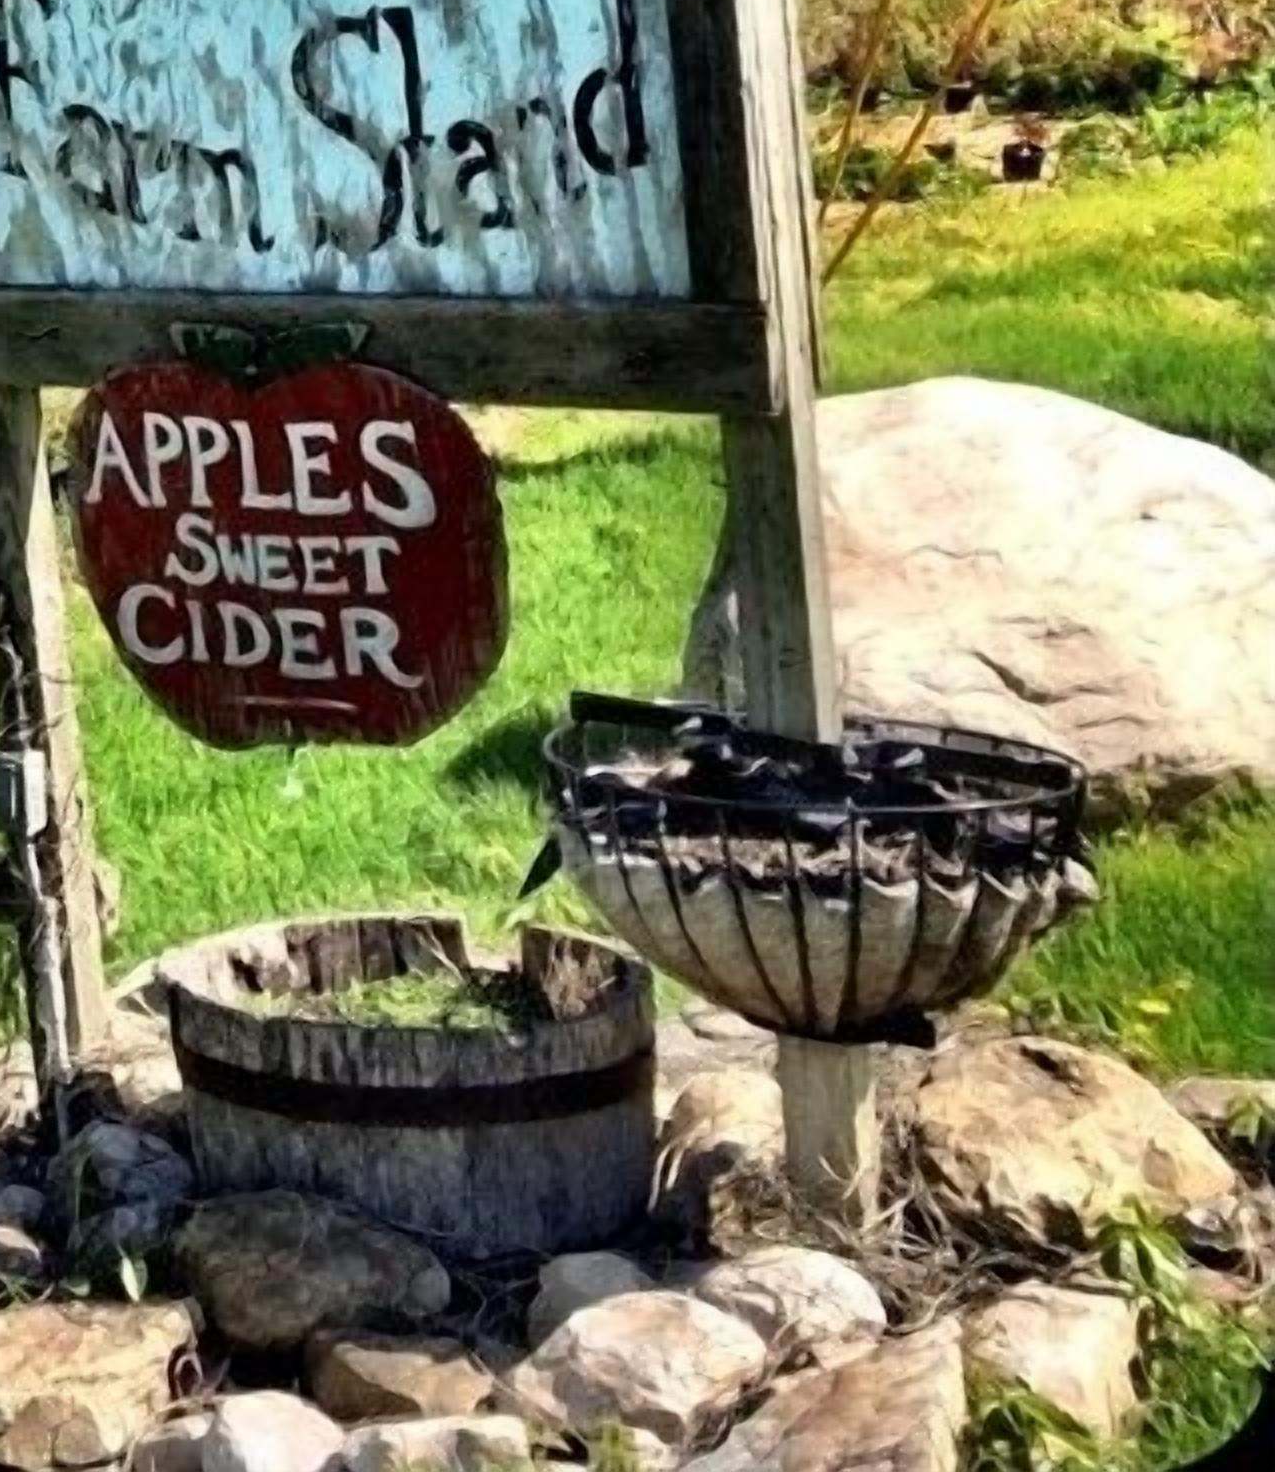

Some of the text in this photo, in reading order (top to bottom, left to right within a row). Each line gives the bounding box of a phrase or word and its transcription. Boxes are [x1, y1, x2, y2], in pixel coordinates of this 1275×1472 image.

[84, 409, 438, 530] APPLES
[164, 511, 401, 595] SWEET
[117, 583, 426, 689] CIDER
